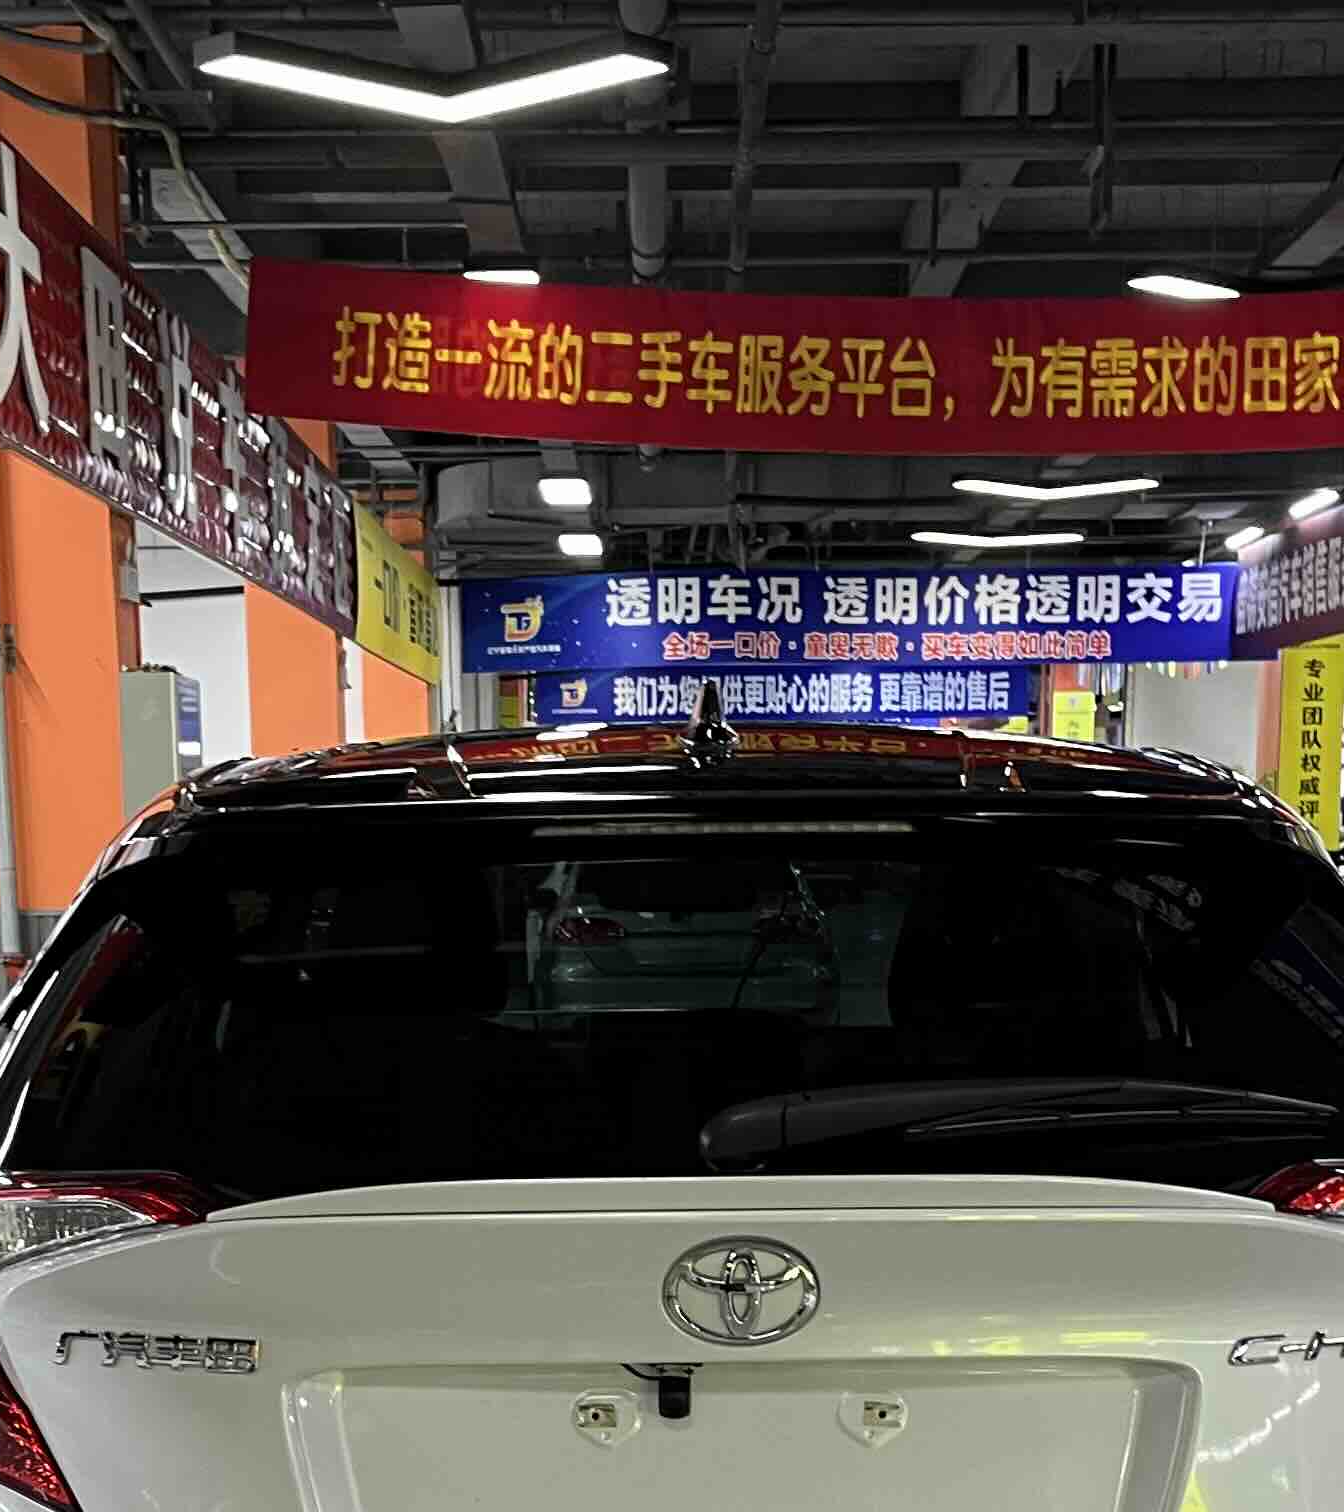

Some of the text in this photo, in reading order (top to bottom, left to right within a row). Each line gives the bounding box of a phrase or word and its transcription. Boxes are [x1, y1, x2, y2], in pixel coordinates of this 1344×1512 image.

[605, 571, 1223, 627] 透明车况 透明价格透明交易
[878, 671, 1011, 713] 更靠谱的售后
[1298, 658, 1326, 831] 专业团队权威评
[50, 1329, 262, 1374] 广汽丰田
